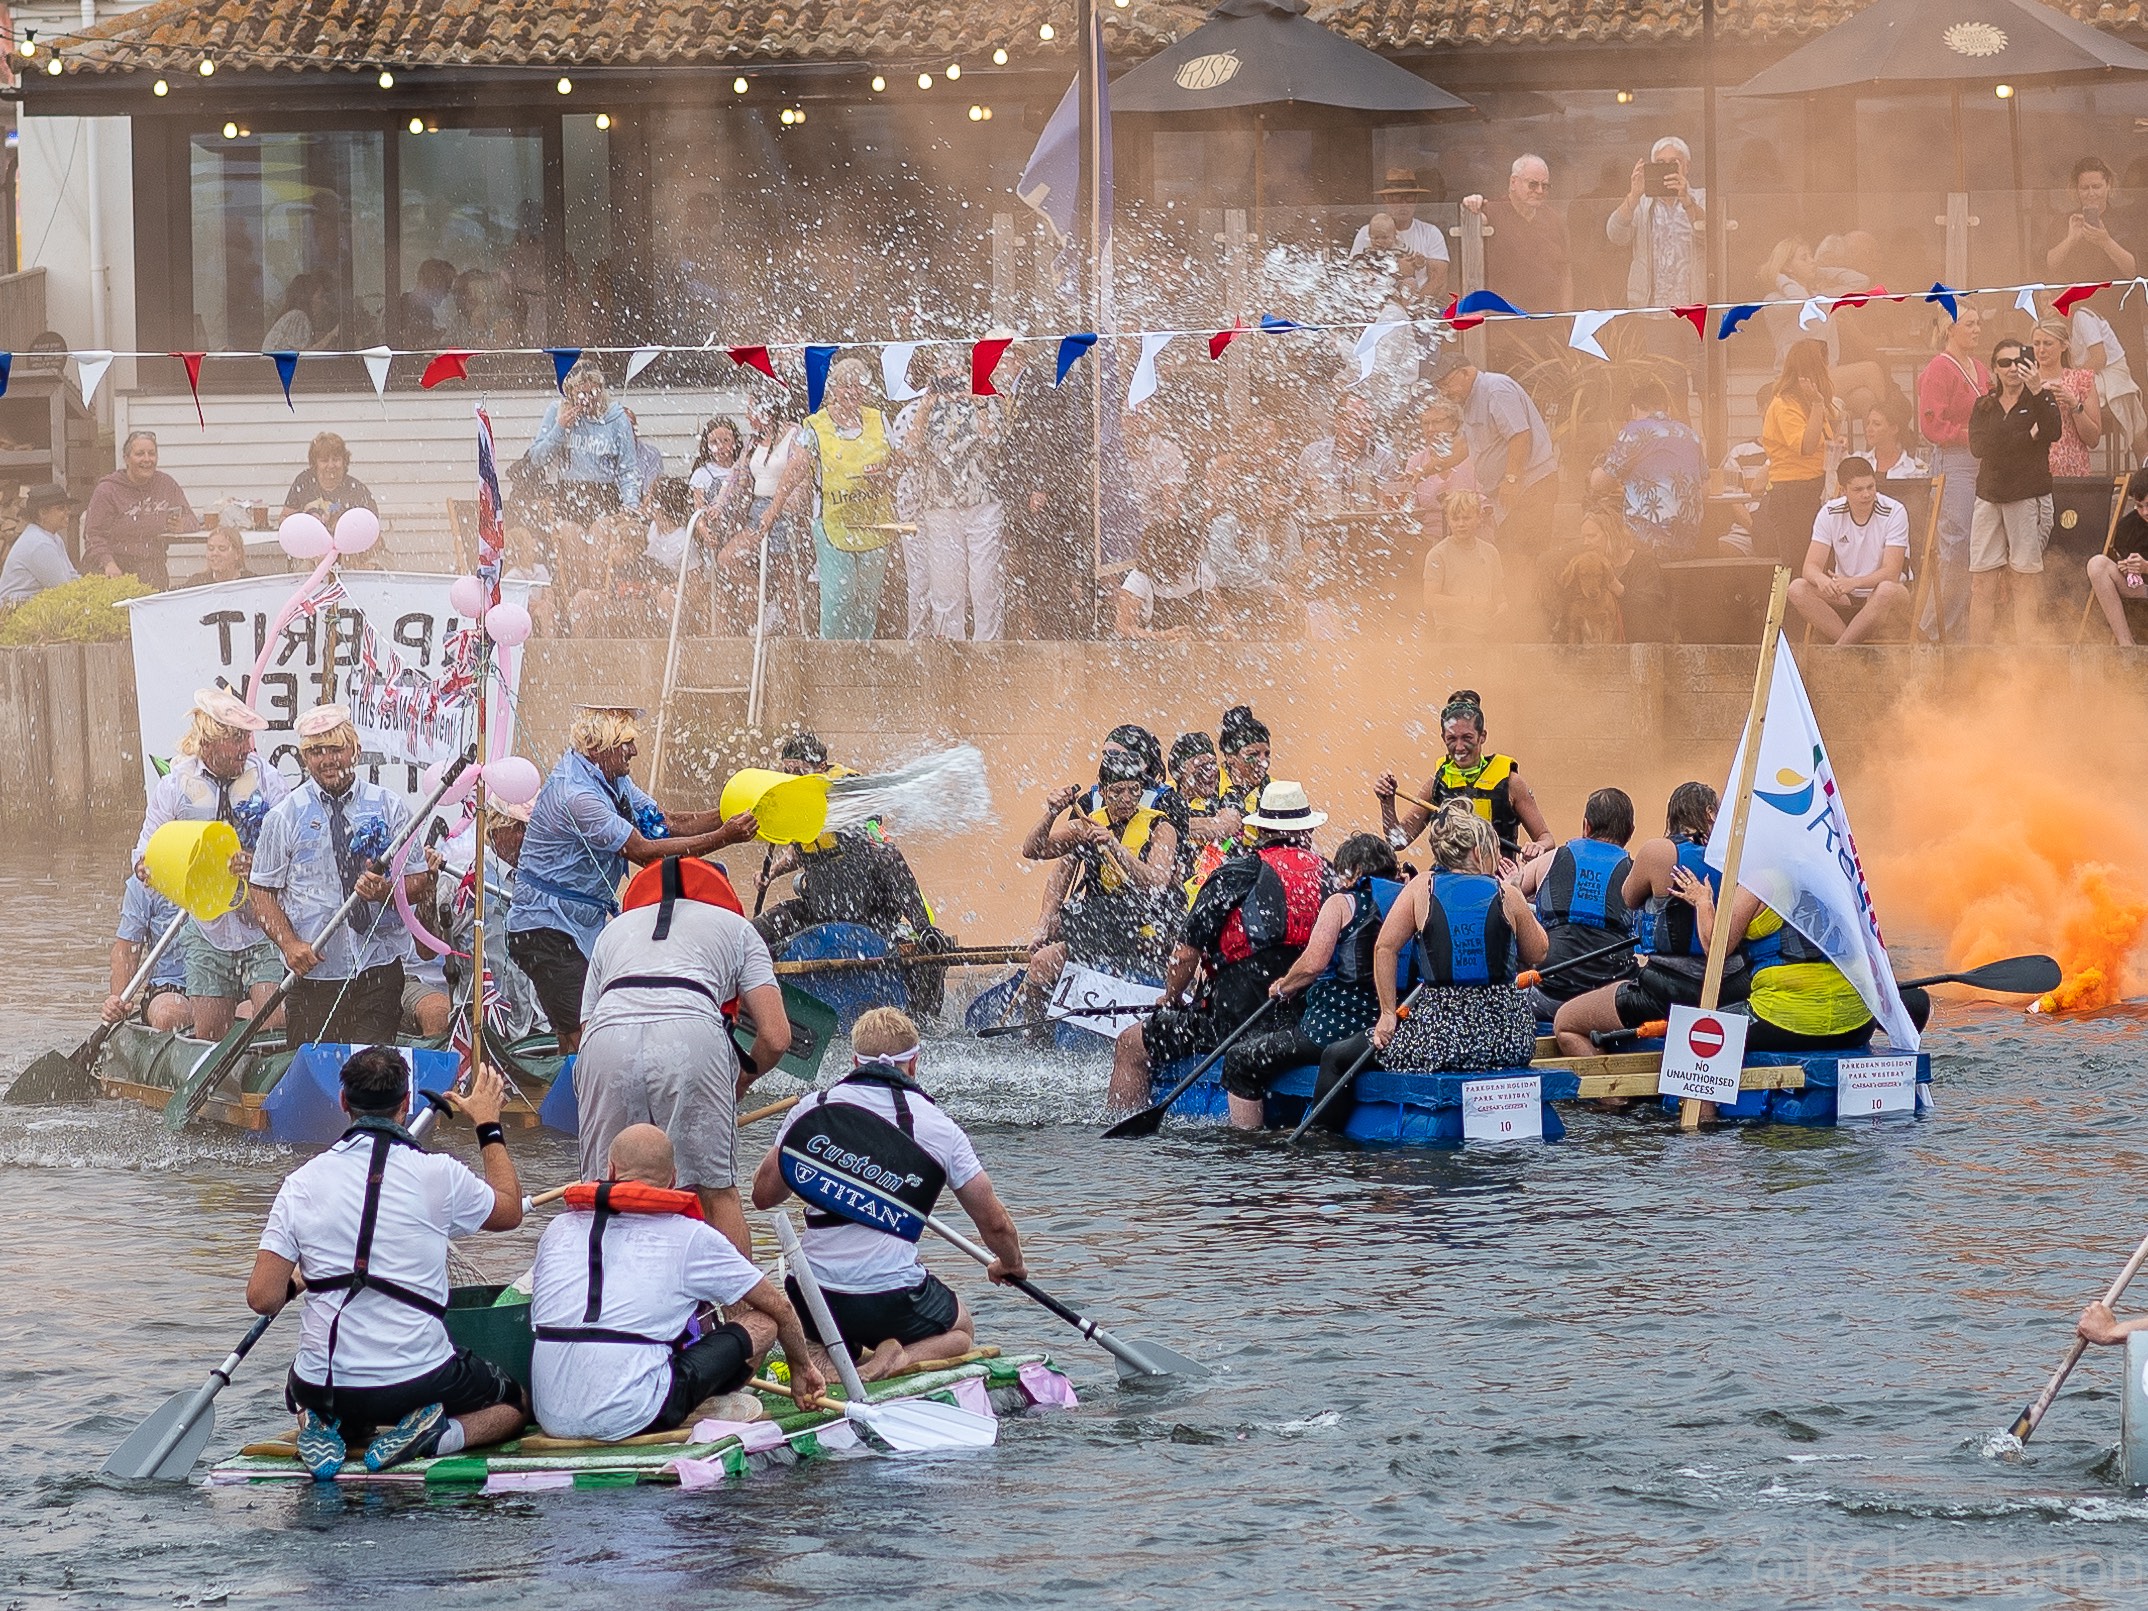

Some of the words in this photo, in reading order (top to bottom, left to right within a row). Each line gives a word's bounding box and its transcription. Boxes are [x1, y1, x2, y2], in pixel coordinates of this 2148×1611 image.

[1179, 54, 1237, 88] RISE
[1453, 922, 1476, 936] ABC
[1694, 1060, 1710, 1073] NO
[1666, 1068, 1735, 1088] UNAUTHORISED
[1682, 1082, 1715, 1096] ACCESS
[1871, 1098, 1882, 1110] 10
[1500, 1121, 1512, 1132] 10
[806, 1134, 904, 1192] Custom
